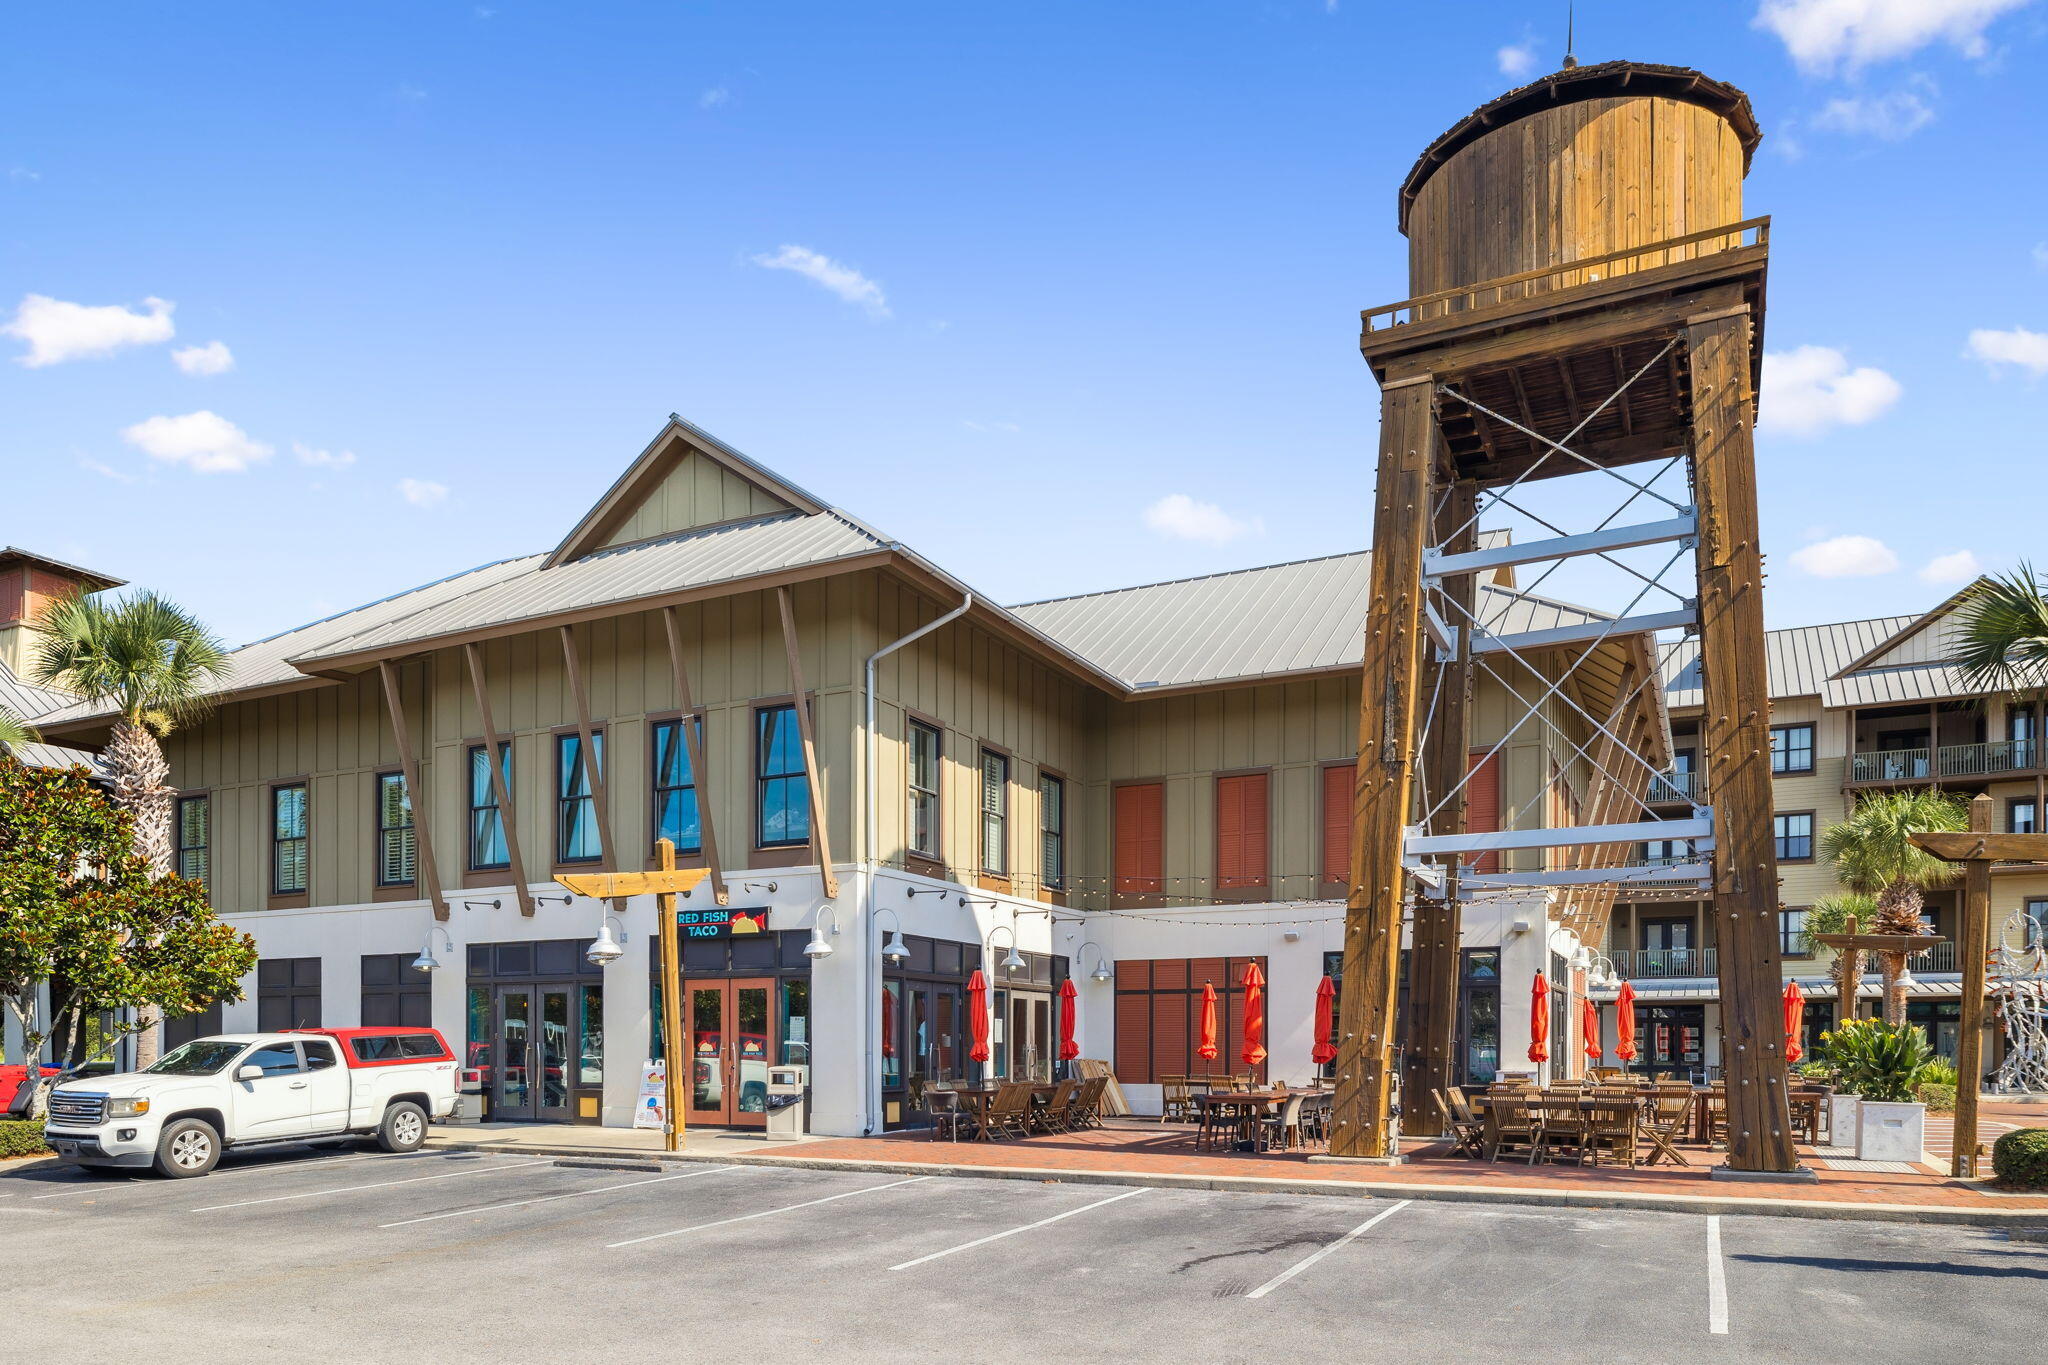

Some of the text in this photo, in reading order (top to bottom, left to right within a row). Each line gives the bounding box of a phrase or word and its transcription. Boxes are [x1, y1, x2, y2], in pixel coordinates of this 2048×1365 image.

[678, 911, 729, 924] RED FISH
[688, 925, 718, 936] TACO
